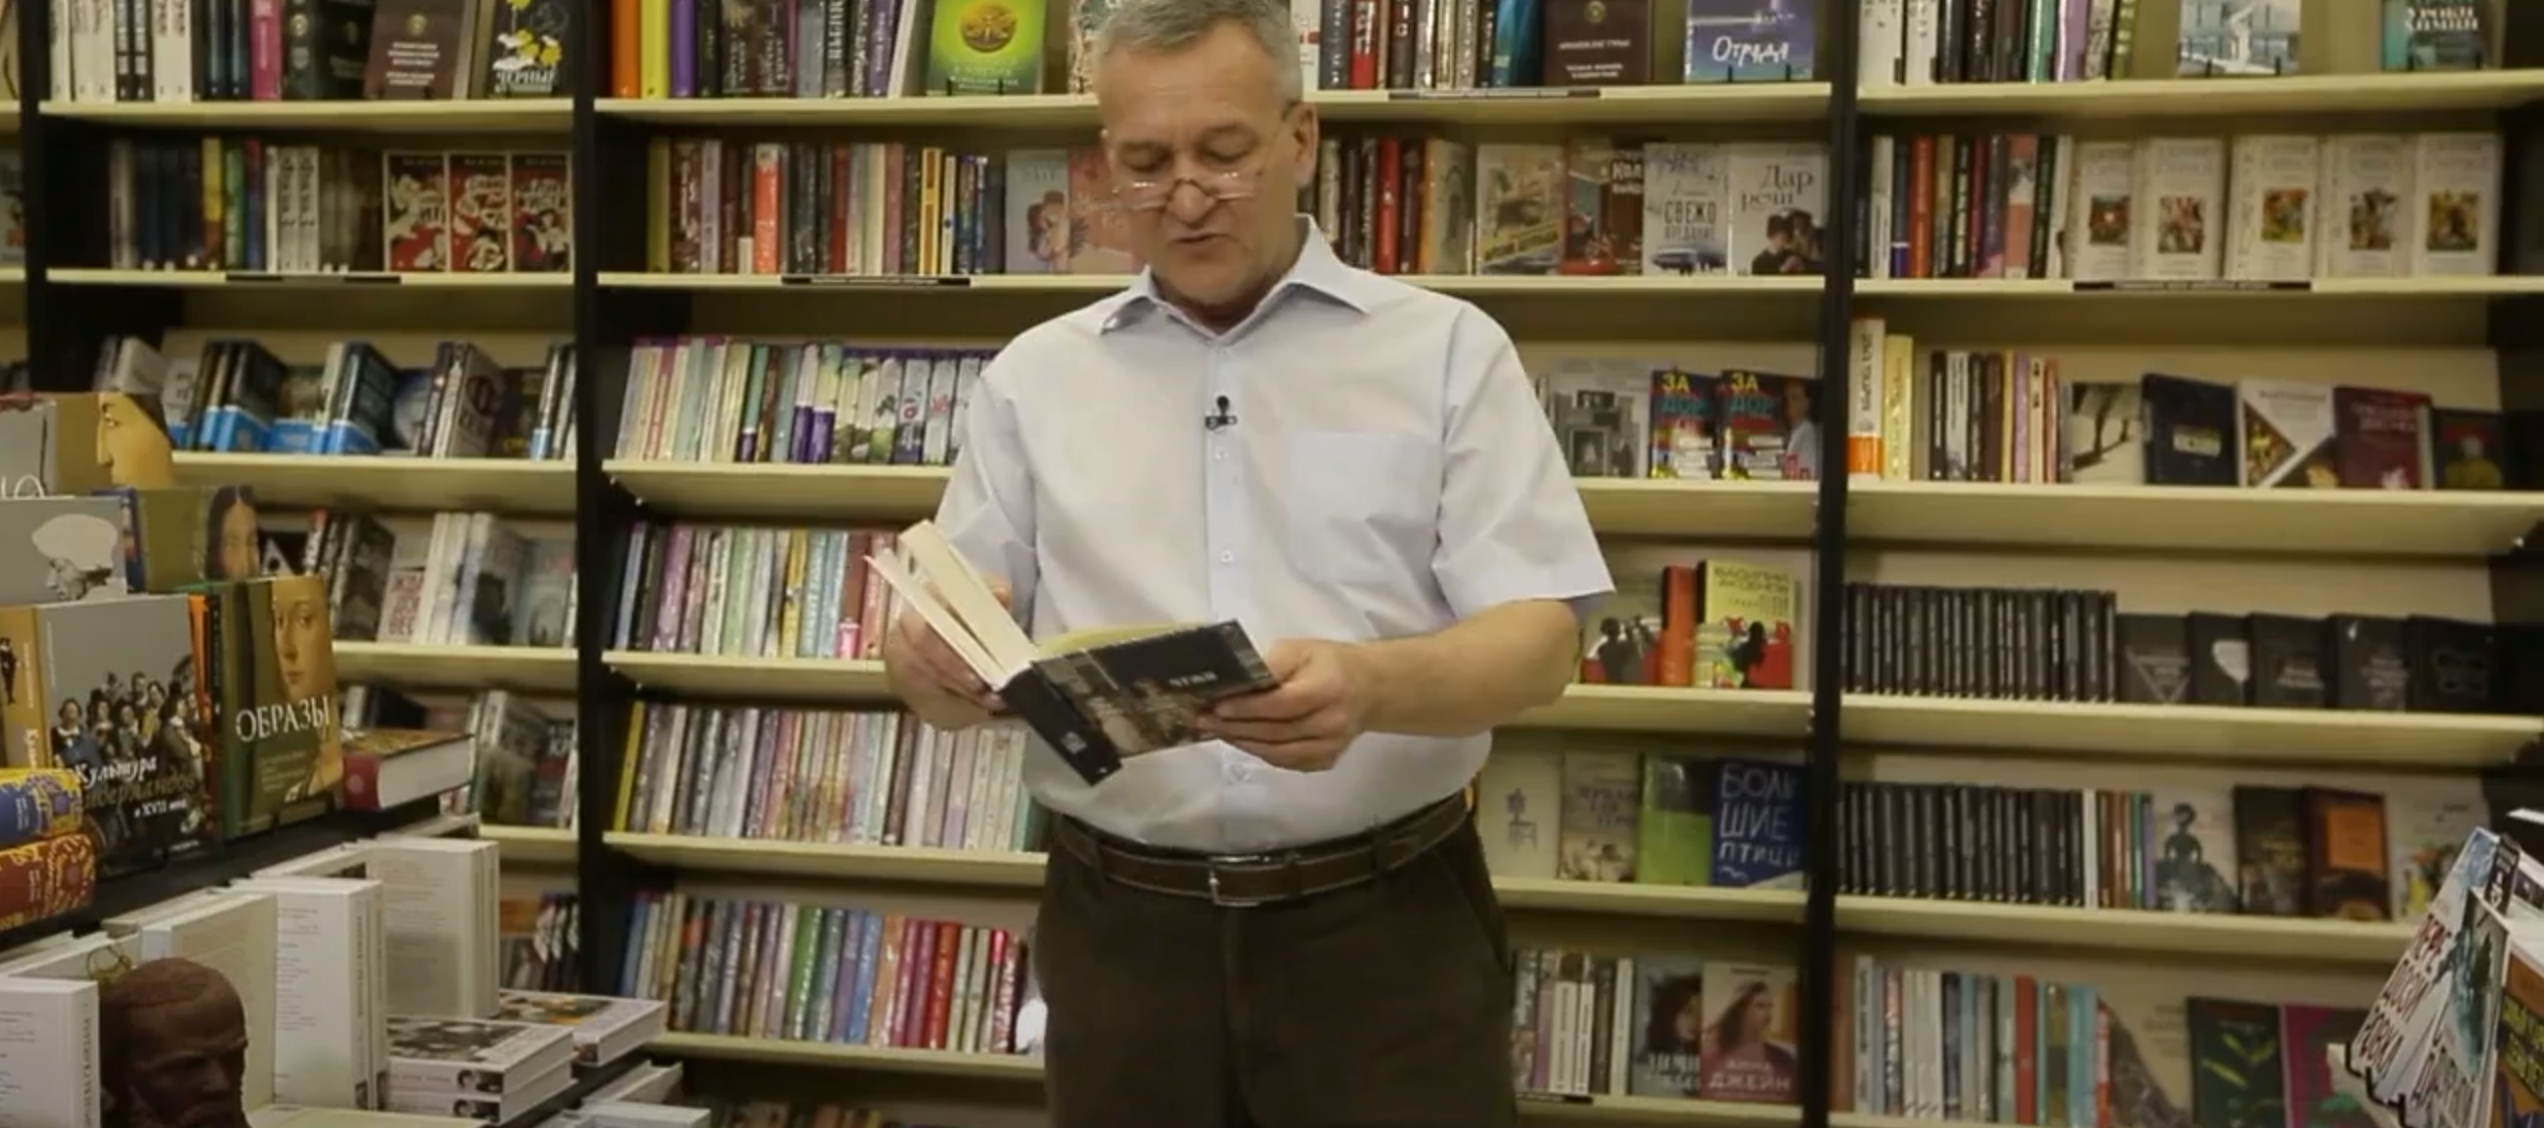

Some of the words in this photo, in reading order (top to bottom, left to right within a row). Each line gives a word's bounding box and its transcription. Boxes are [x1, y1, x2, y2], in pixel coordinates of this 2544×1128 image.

[1761, 165, 1814, 195] Дар
[1665, 201, 1717, 224] СВЕЖО
[1663, 373, 1690, 392] ЗА
[1731, 372, 1759, 392] ЗА
[236, 695, 330, 742] ОБРАЗЫ
[75, 757, 157, 790] Культура
[1720, 801, 1791, 840] ШИЕ
